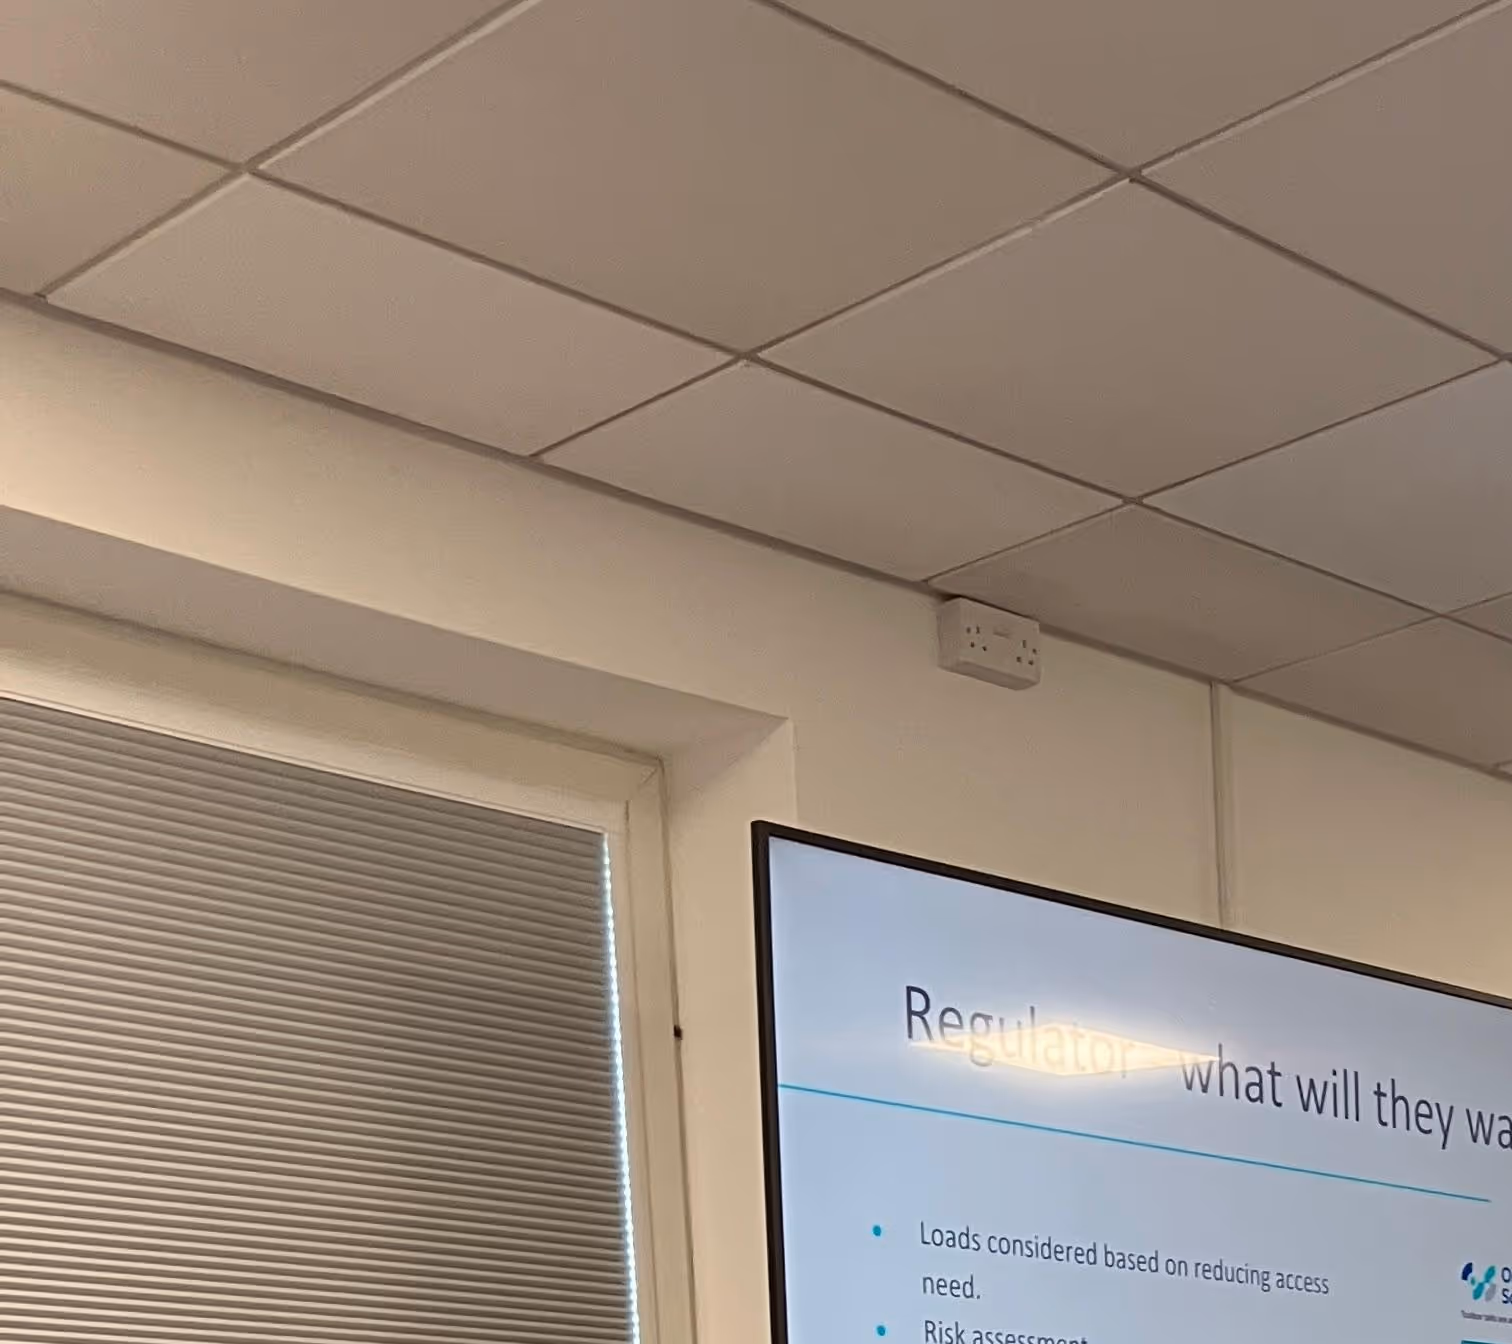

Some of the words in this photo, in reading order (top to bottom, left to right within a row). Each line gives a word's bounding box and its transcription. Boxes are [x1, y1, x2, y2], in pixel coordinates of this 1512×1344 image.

[1179, 1043, 1282, 1108] what
[1296, 1069, 1359, 1122] will
[1374, 1079, 1454, 1150] they
[921, 1222, 980, 1251] Loads
[988, 1236, 1097, 1265] considered
[1104, 1244, 1158, 1272] based
[1165, 1259, 1188, 1276] on
[1195, 1259, 1270, 1292] reducing
[1276, 1273, 1329, 1294] access
[923, 1275, 980, 1299] need.
